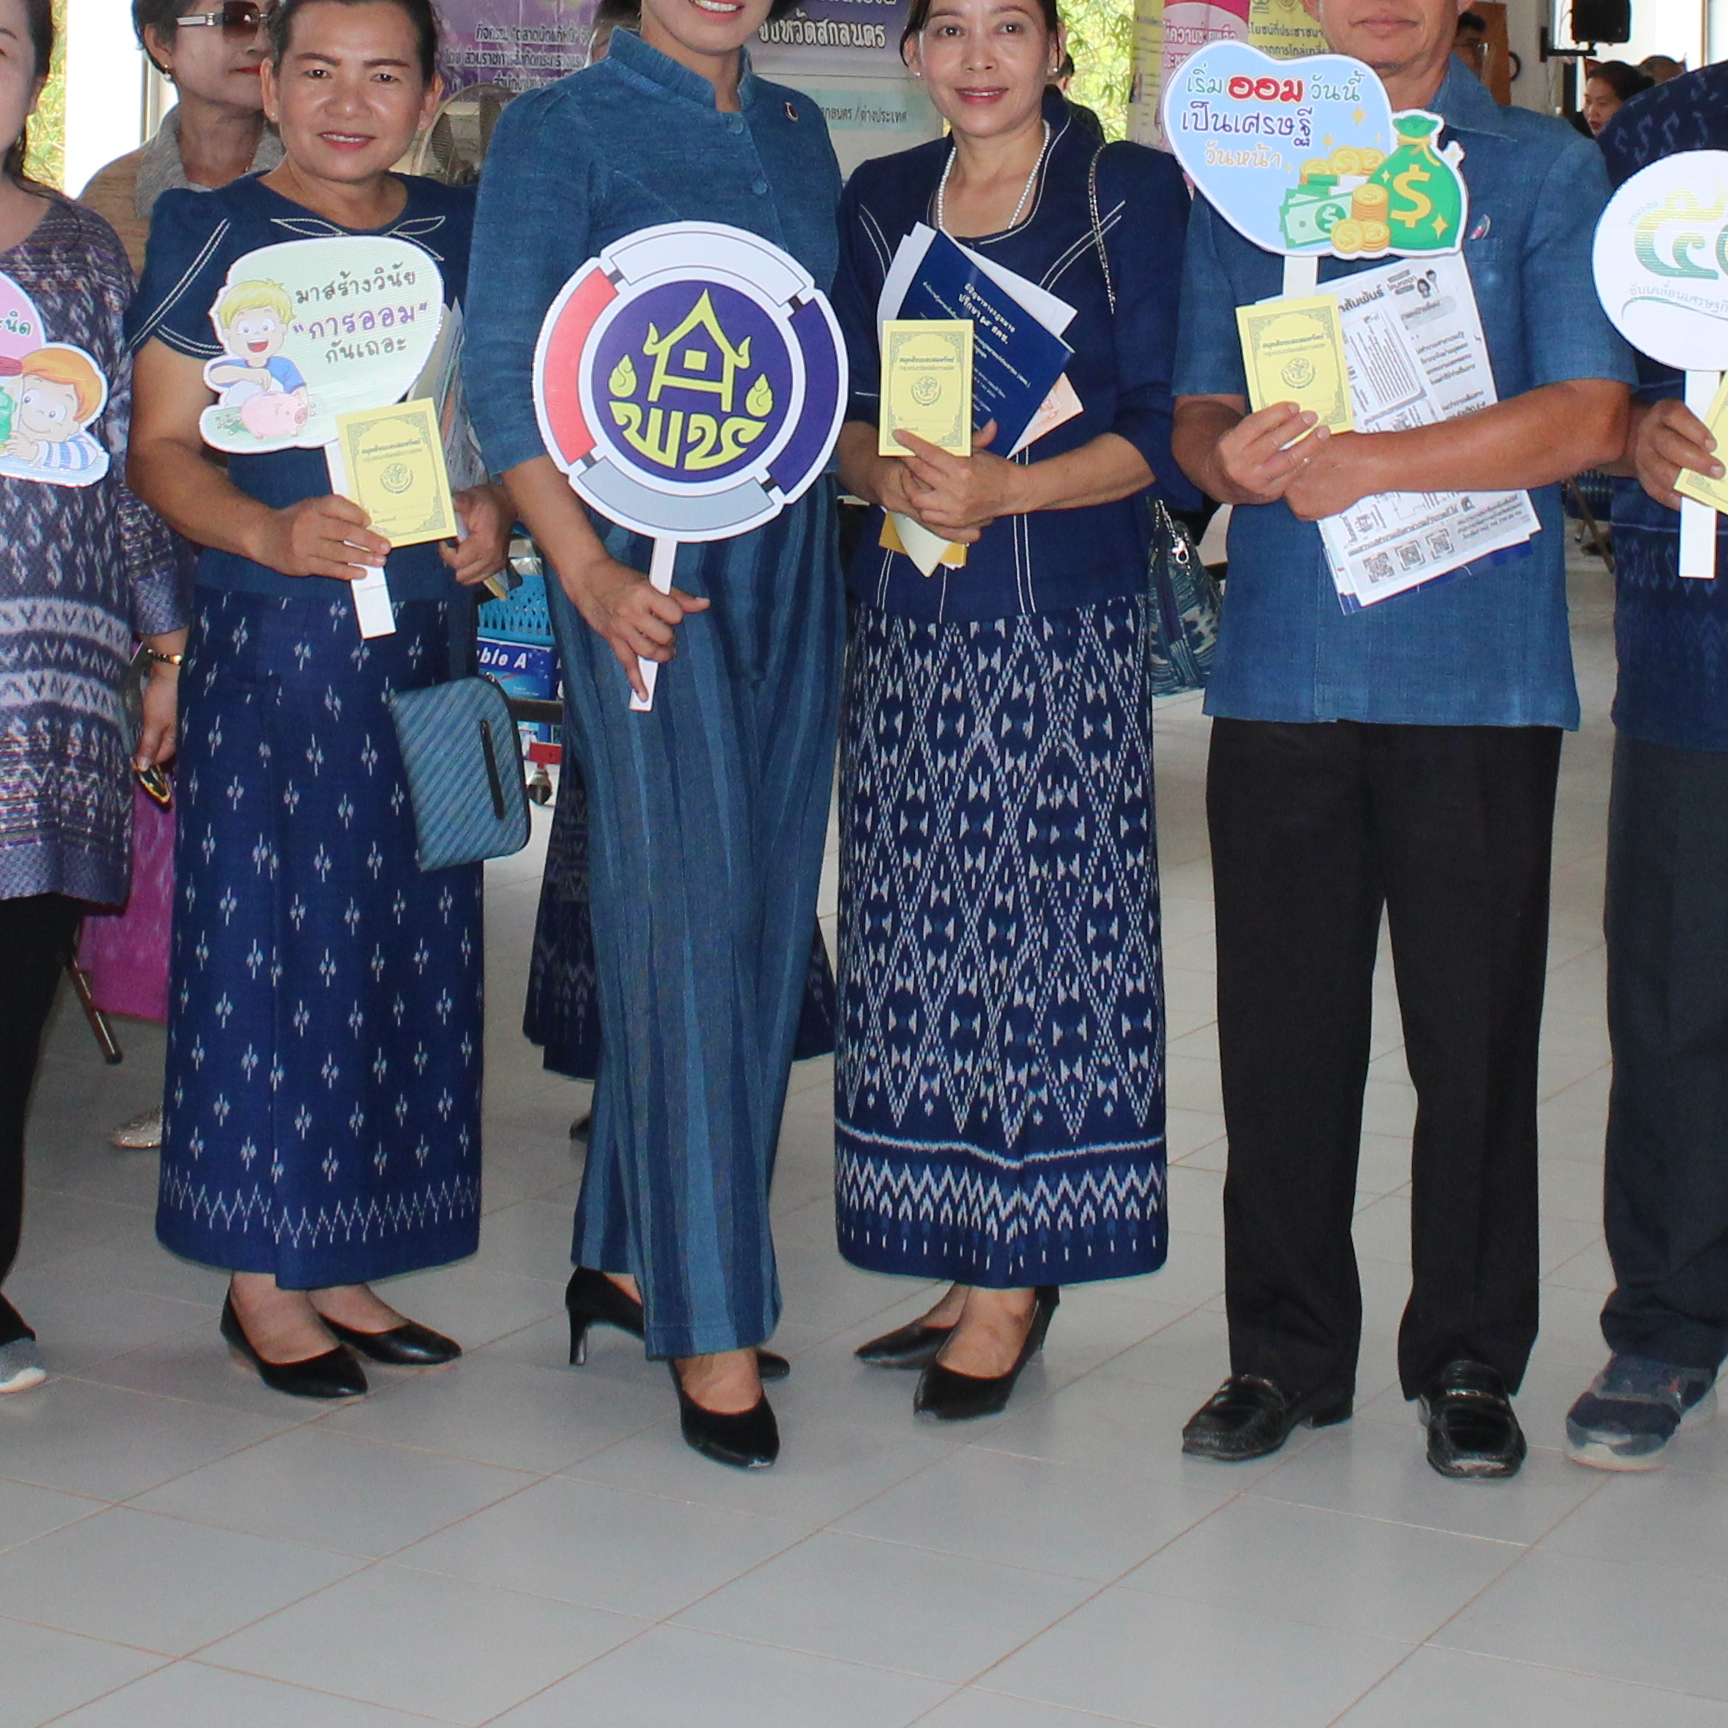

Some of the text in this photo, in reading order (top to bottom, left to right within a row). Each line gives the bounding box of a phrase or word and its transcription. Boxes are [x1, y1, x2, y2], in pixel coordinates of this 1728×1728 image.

[1187, 62, 1366, 103] เริ่ม ออม วันนี้
[1182, 101, 1313, 148] เป็นเศรษฐี
[1205, 142, 1281, 168] วันหน้า
[295, 261, 416, 304] มาสร้างวินัย
[325, 337, 407, 363] กันเถอะ
[477, 646, 527, 669] ble A
